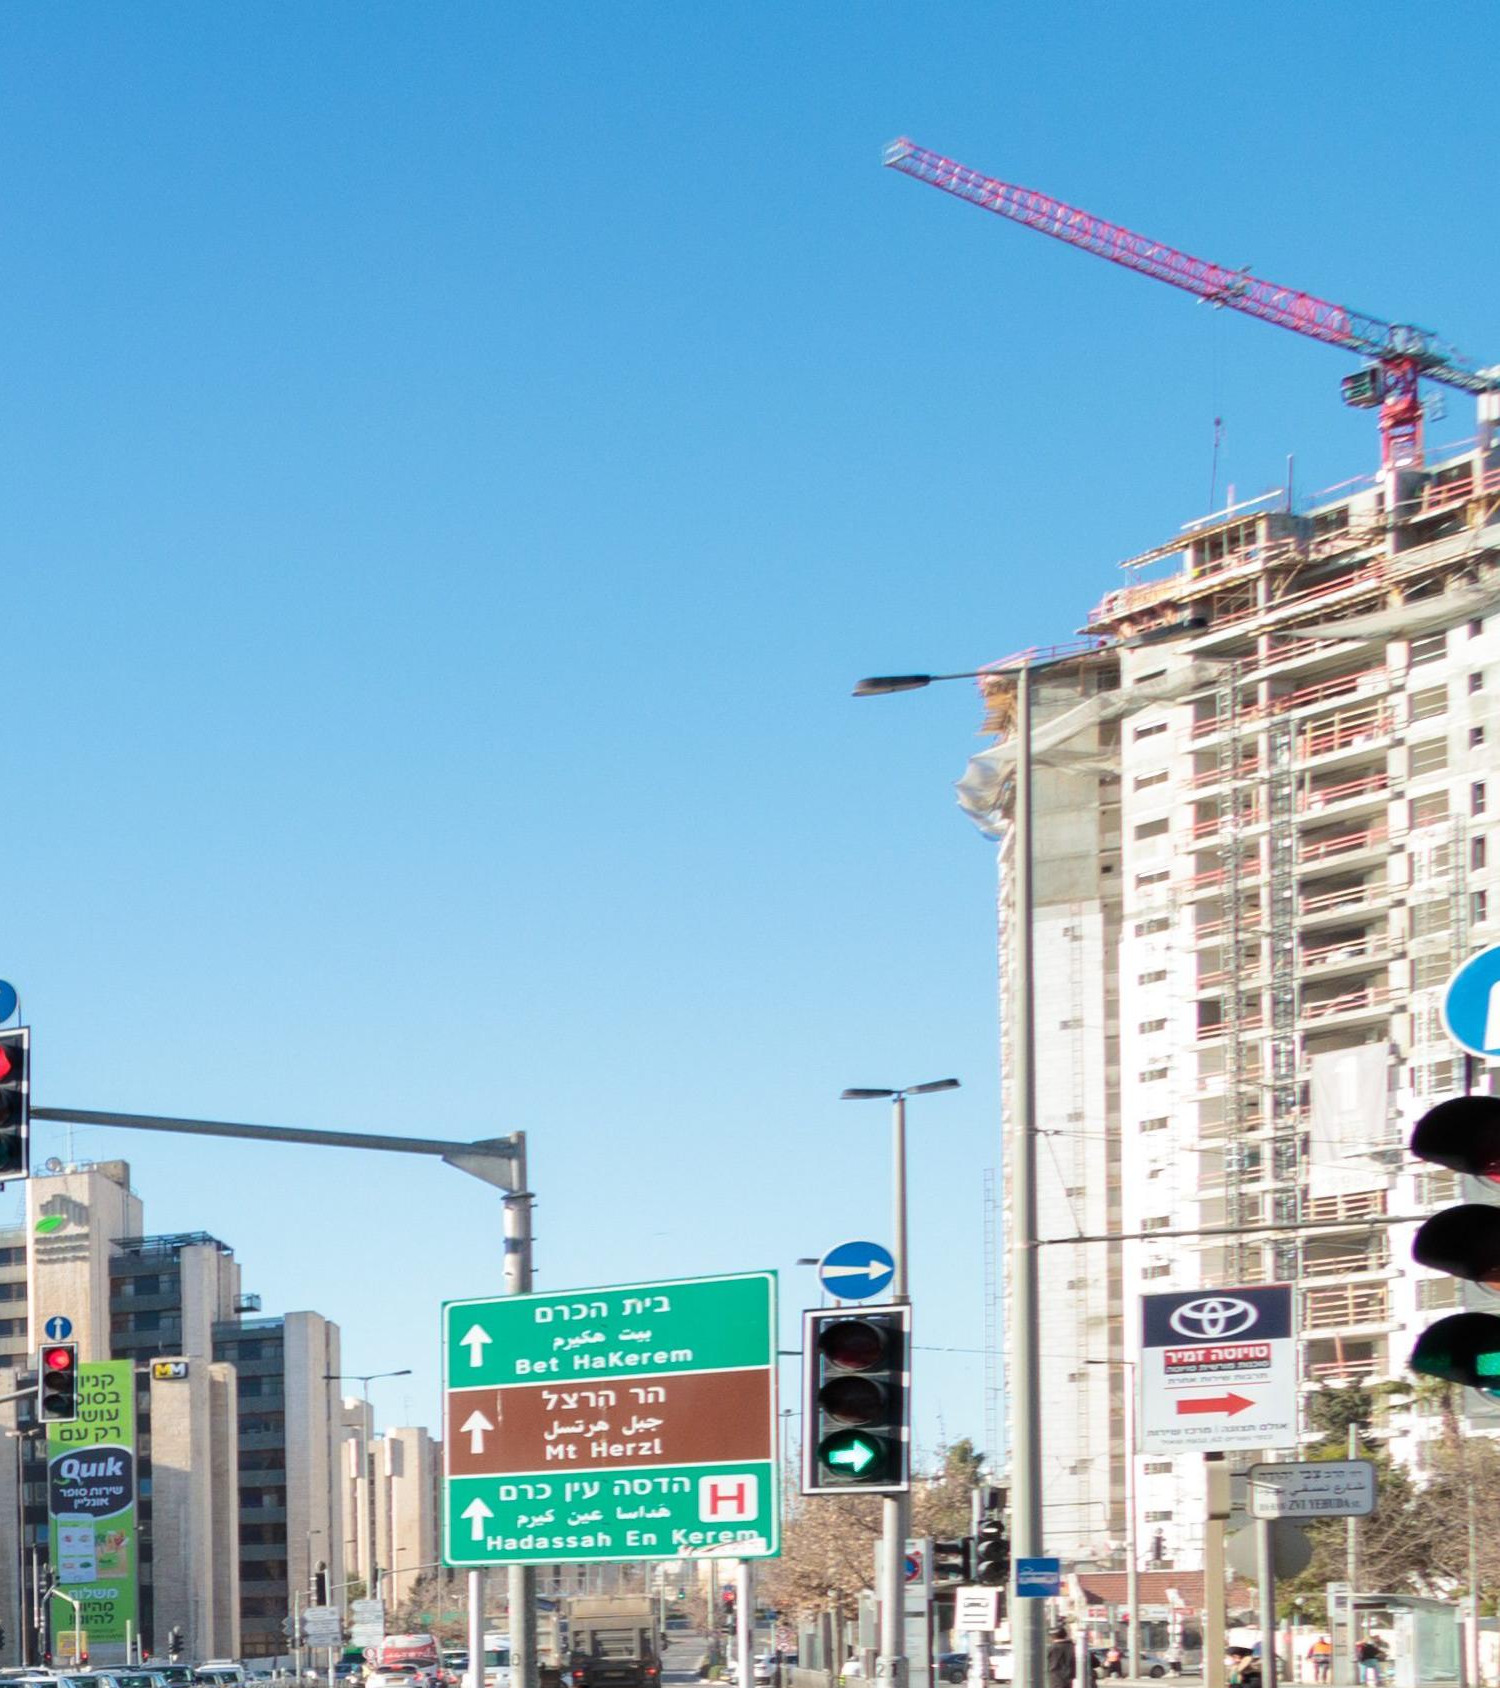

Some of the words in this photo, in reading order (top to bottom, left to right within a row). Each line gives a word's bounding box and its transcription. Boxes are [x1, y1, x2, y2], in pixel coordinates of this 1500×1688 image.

[535, 1301, 608, 1323] הכרם
[621, 1295, 671, 1315] בית
[553, 1329, 606, 1350] هكيرم
[619, 1326, 651, 1343] بيت
[516, 1356, 559, 1375] Bet
[573, 1347, 693, 1370] HaKerem
[1166, 1348, 1206, 1363] זמיר
[1210, 1345, 1268, 1360] טויוטה
[156, 1362, 186, 1378] MM
[81, 1374, 115, 1390] קניו
[77, 1391, 120, 1405] בסו
[542, 1388, 616, 1410] הרצל
[630, 1385, 666, 1404] הר
[544, 1418, 610, 1440] هرتسل
[623, 1415, 663, 1433] جبل
[60, 1428, 88, 1441] עם
[95, 1426, 120, 1443] רק
[545, 1440, 577, 1460] Mt
[591, 1438, 662, 1457] Herzl
[61, 1457, 124, 1486] Quik
[60, 1488, 88, 1497] סופר
[90, 1486, 124, 1496] שירות
[500, 1481, 552, 1503] כרם
[565, 1478, 600, 1501] עין
[614, 1476, 690, 1497] הדסה
[709, 1482, 745, 1515] H
[517, 1507, 555, 1528] كيرم
[567, 1506, 604, 1526] عين
[486, 1531, 612, 1552] Hadassah
[626, 1529, 657, 1546] En
[672, 1526, 758, 1546] Kerem
